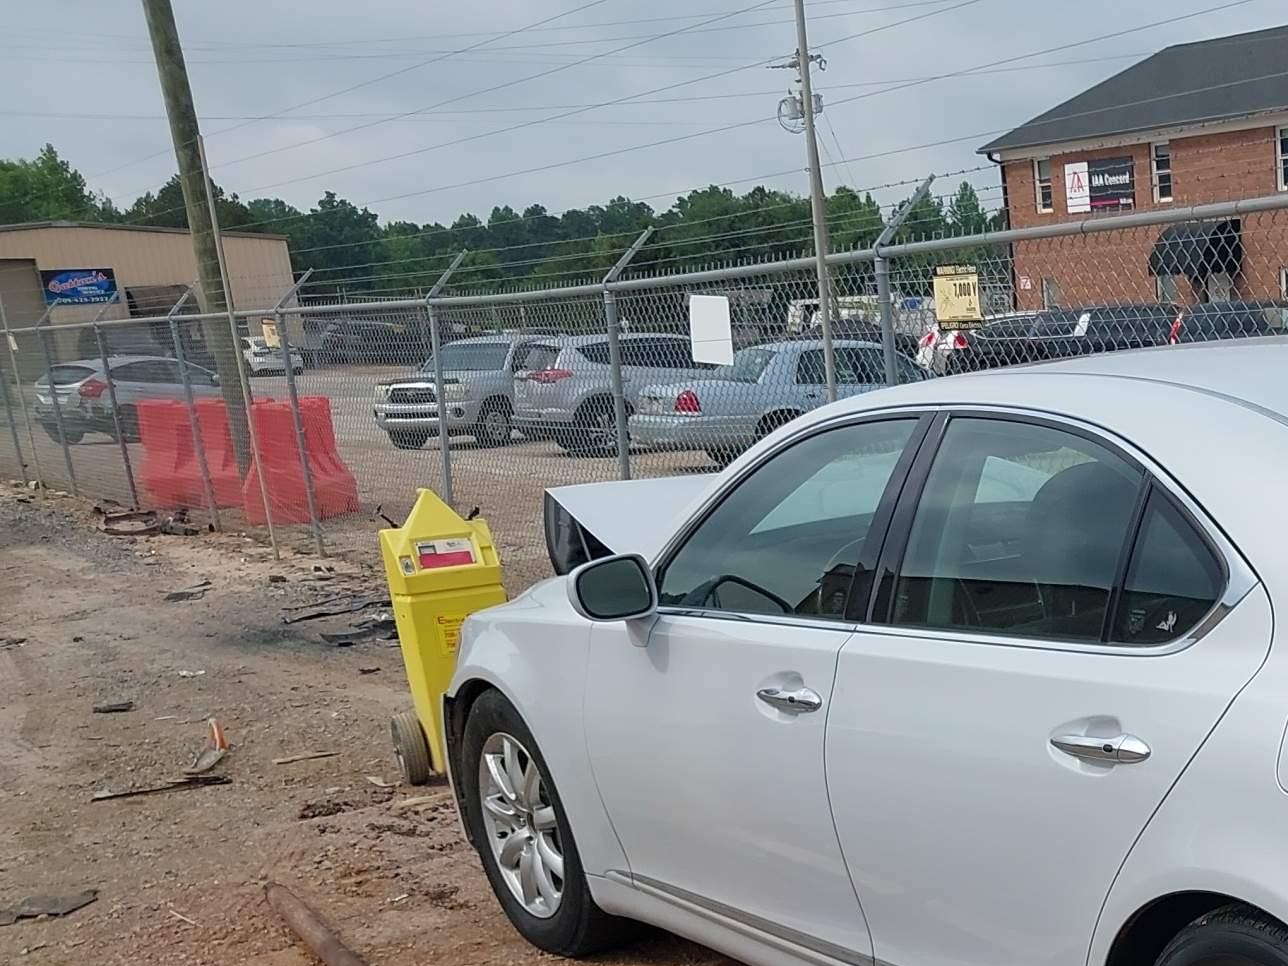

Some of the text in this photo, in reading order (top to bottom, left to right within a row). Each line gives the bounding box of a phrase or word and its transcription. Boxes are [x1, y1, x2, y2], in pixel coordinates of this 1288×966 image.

[1092, 171, 1130, 187] IAA Concord
[953, 282, 971, 299] 7,000
